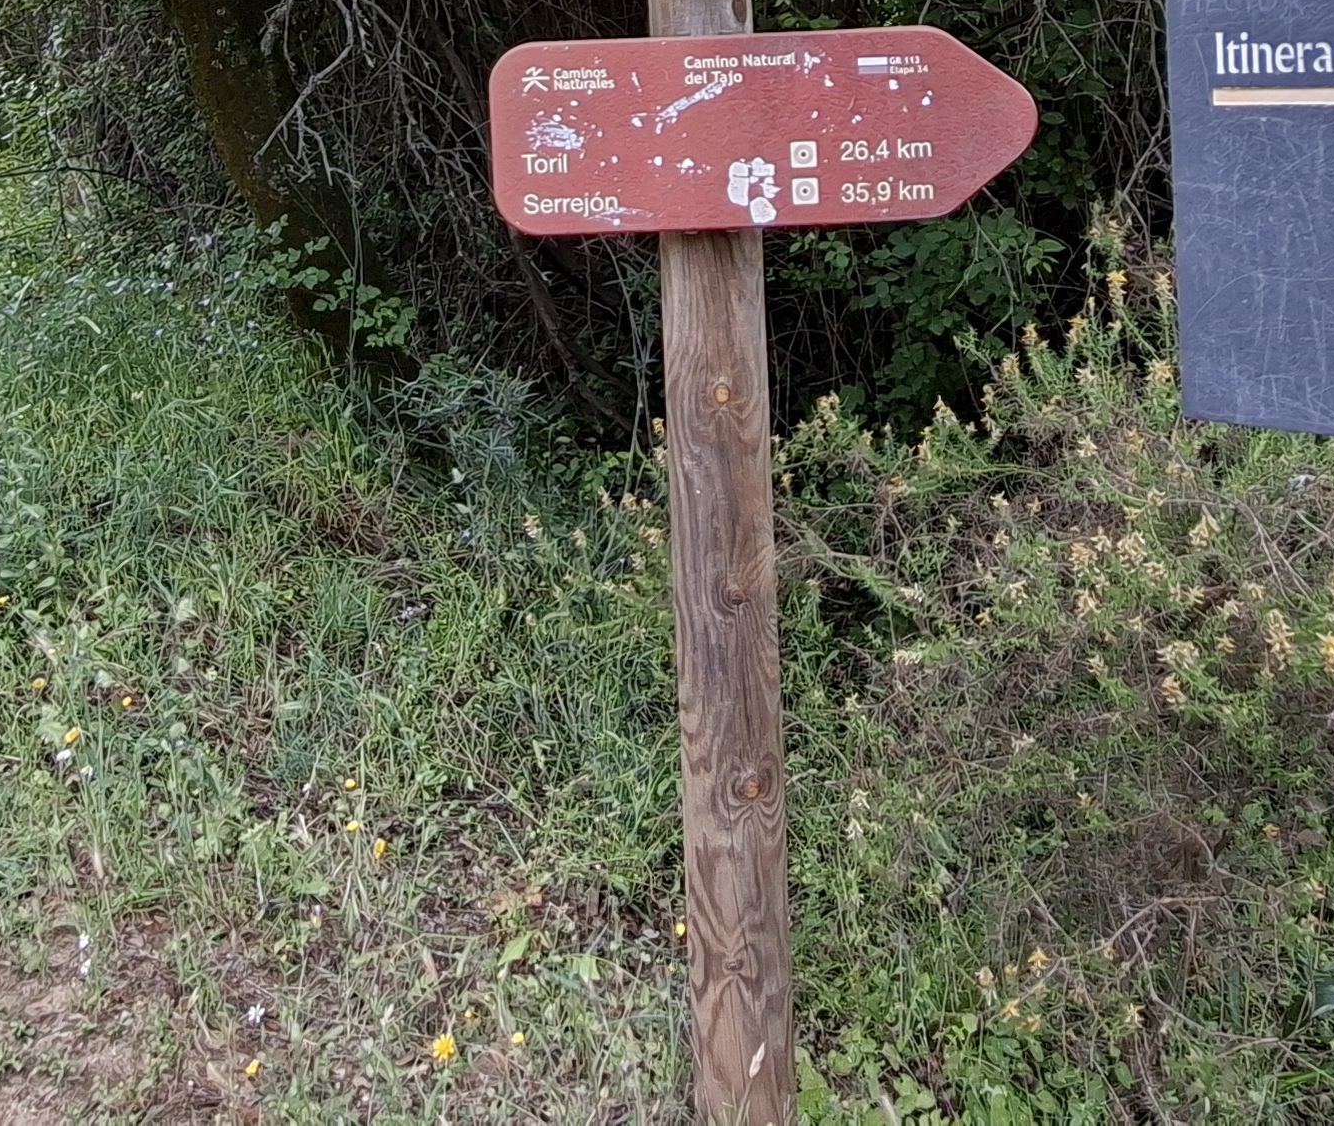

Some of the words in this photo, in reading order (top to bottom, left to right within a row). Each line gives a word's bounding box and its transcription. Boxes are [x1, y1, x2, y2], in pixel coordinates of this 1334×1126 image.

[684, 55, 738, 68] Camino
[742, 52, 796, 68] Natural
[889, 56, 902, 65] GR
[553, 67, 609, 80] Caminos
[685, 71, 707, 85] del
[710, 70, 743, 86] Tajo
[889, 66, 915, 75] Etapa
[553, 77, 615, 91] Naturales
[521, 152, 569, 175] Toril
[840, 141, 891, 162] 26,4
[897, 139, 933, 159] km
[523, 192, 619, 215] Serrejón
[840, 182, 892, 205] 35,9
[898, 181, 935, 201] km
